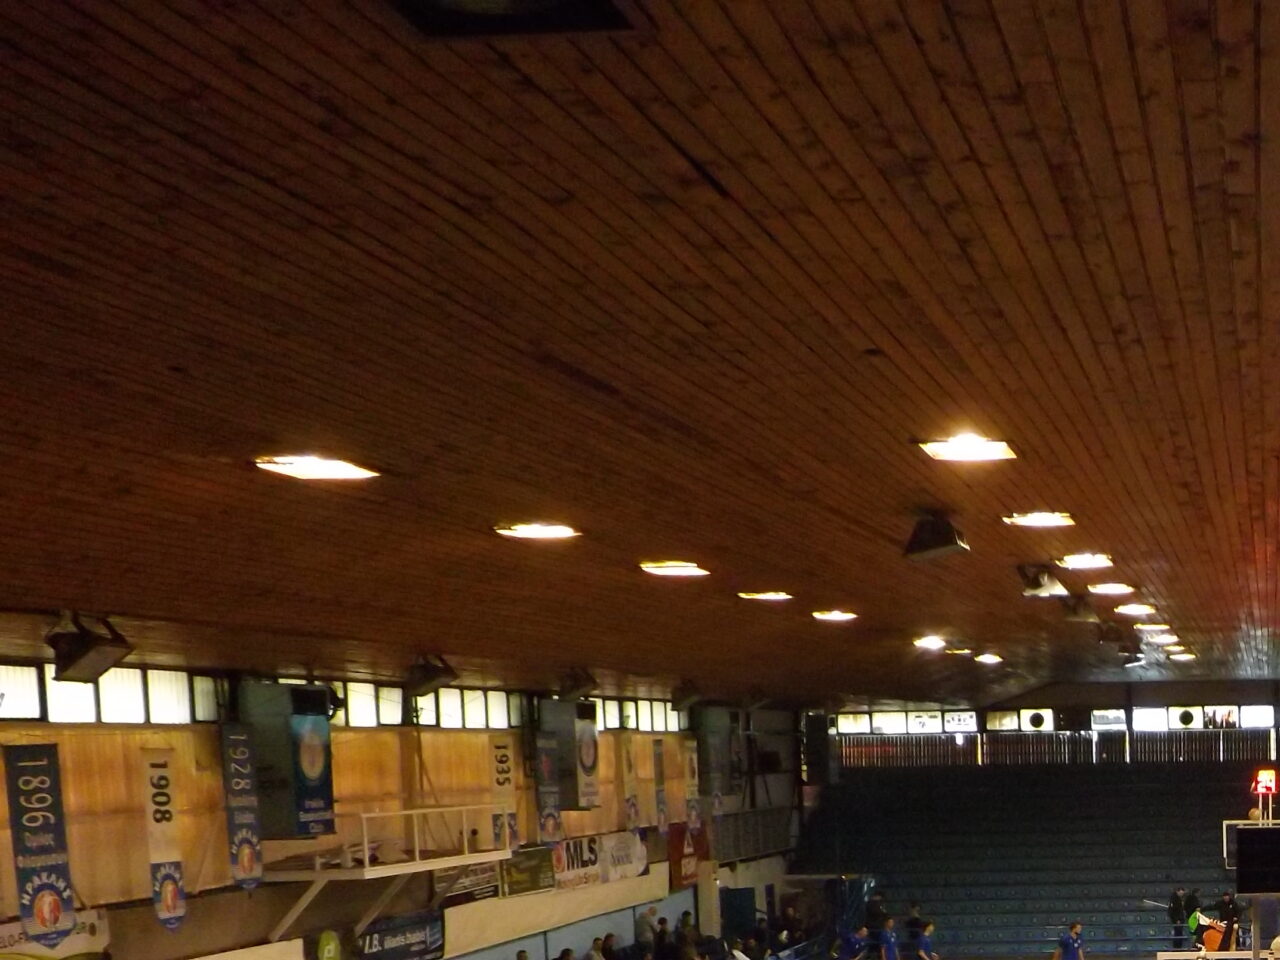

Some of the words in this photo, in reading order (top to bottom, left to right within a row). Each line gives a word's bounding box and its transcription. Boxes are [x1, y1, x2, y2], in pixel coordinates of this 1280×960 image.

[229, 733, 251, 790] 1928
[494, 744, 512, 786] 1935
[17, 757, 56, 827] 1896
[149, 760, 173, 824] 1908
[565, 837, 598, 871] MLS
